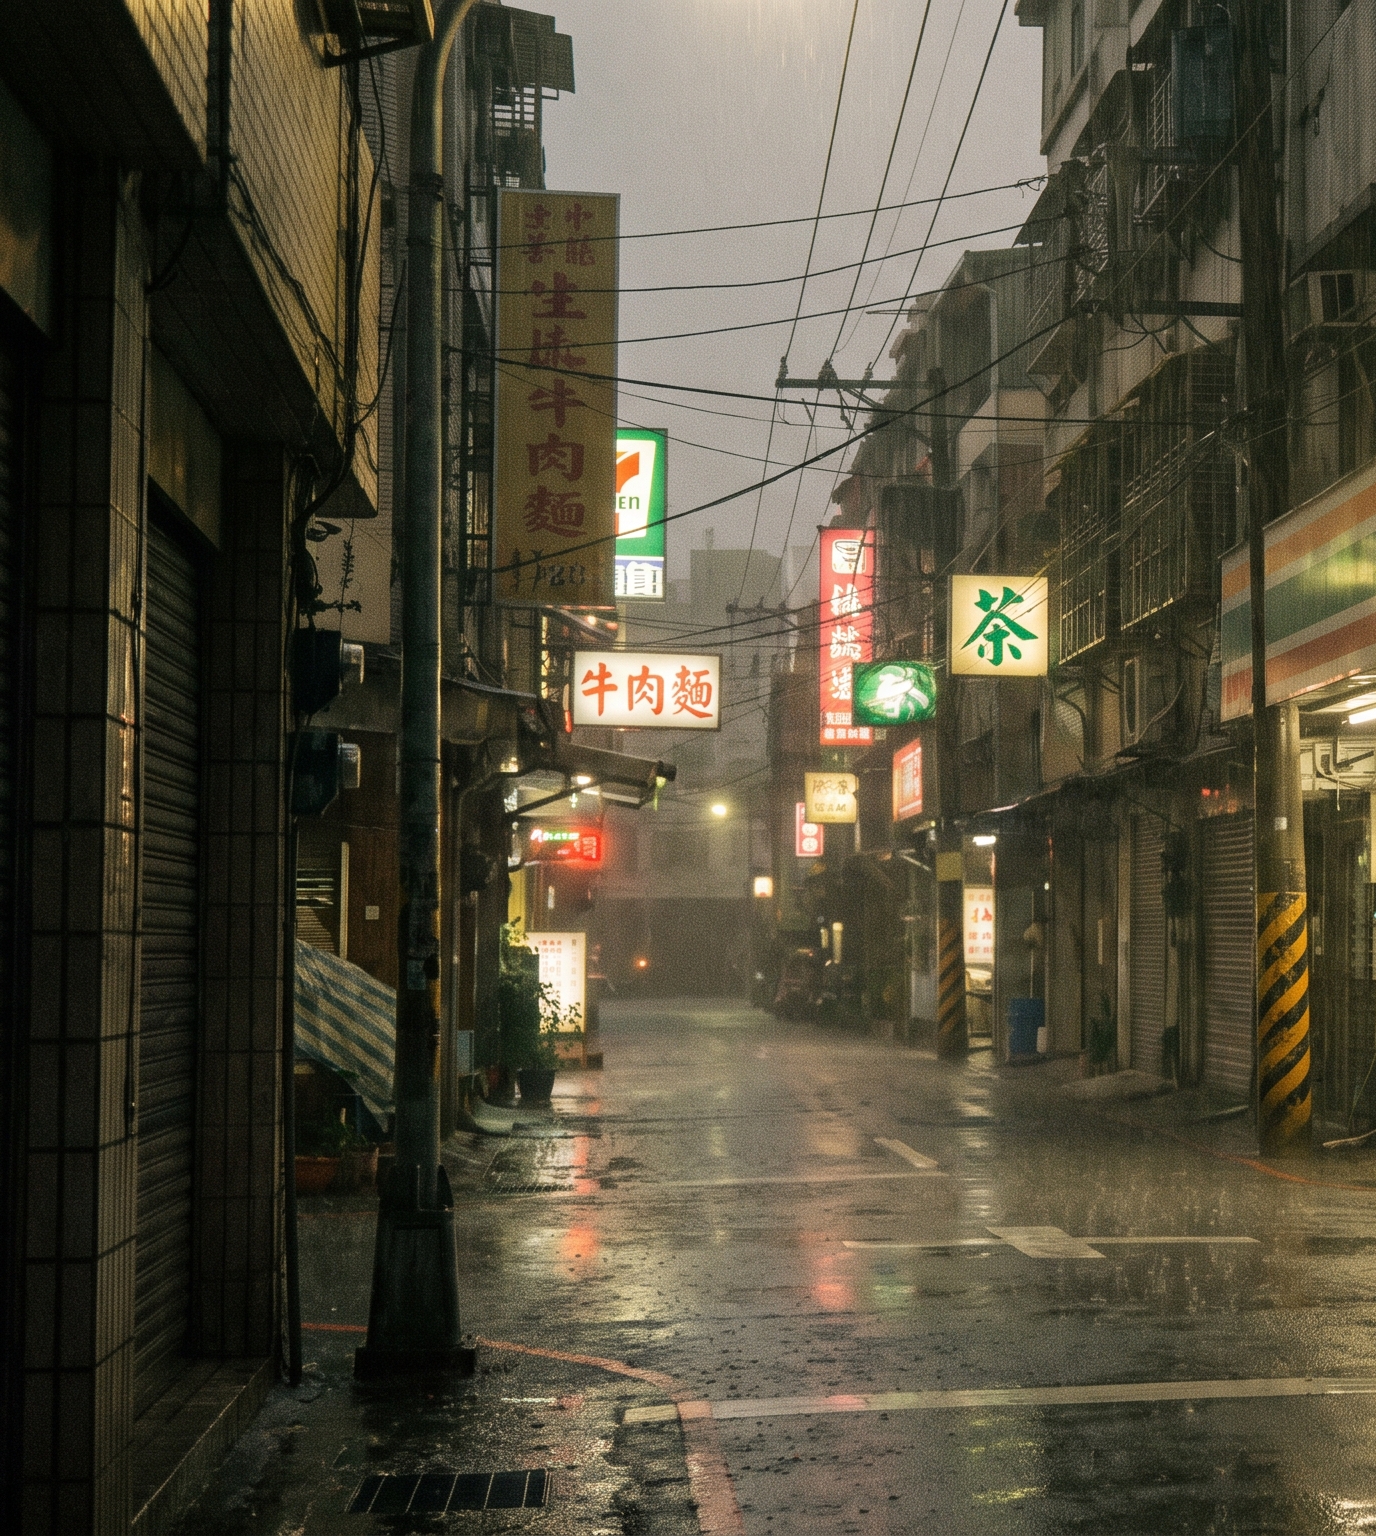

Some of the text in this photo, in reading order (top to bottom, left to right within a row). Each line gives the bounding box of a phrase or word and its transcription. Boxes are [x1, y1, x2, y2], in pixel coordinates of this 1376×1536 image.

[960, 586, 1039, 667] 茶
[581, 661, 713, 719] 牛肉麵
